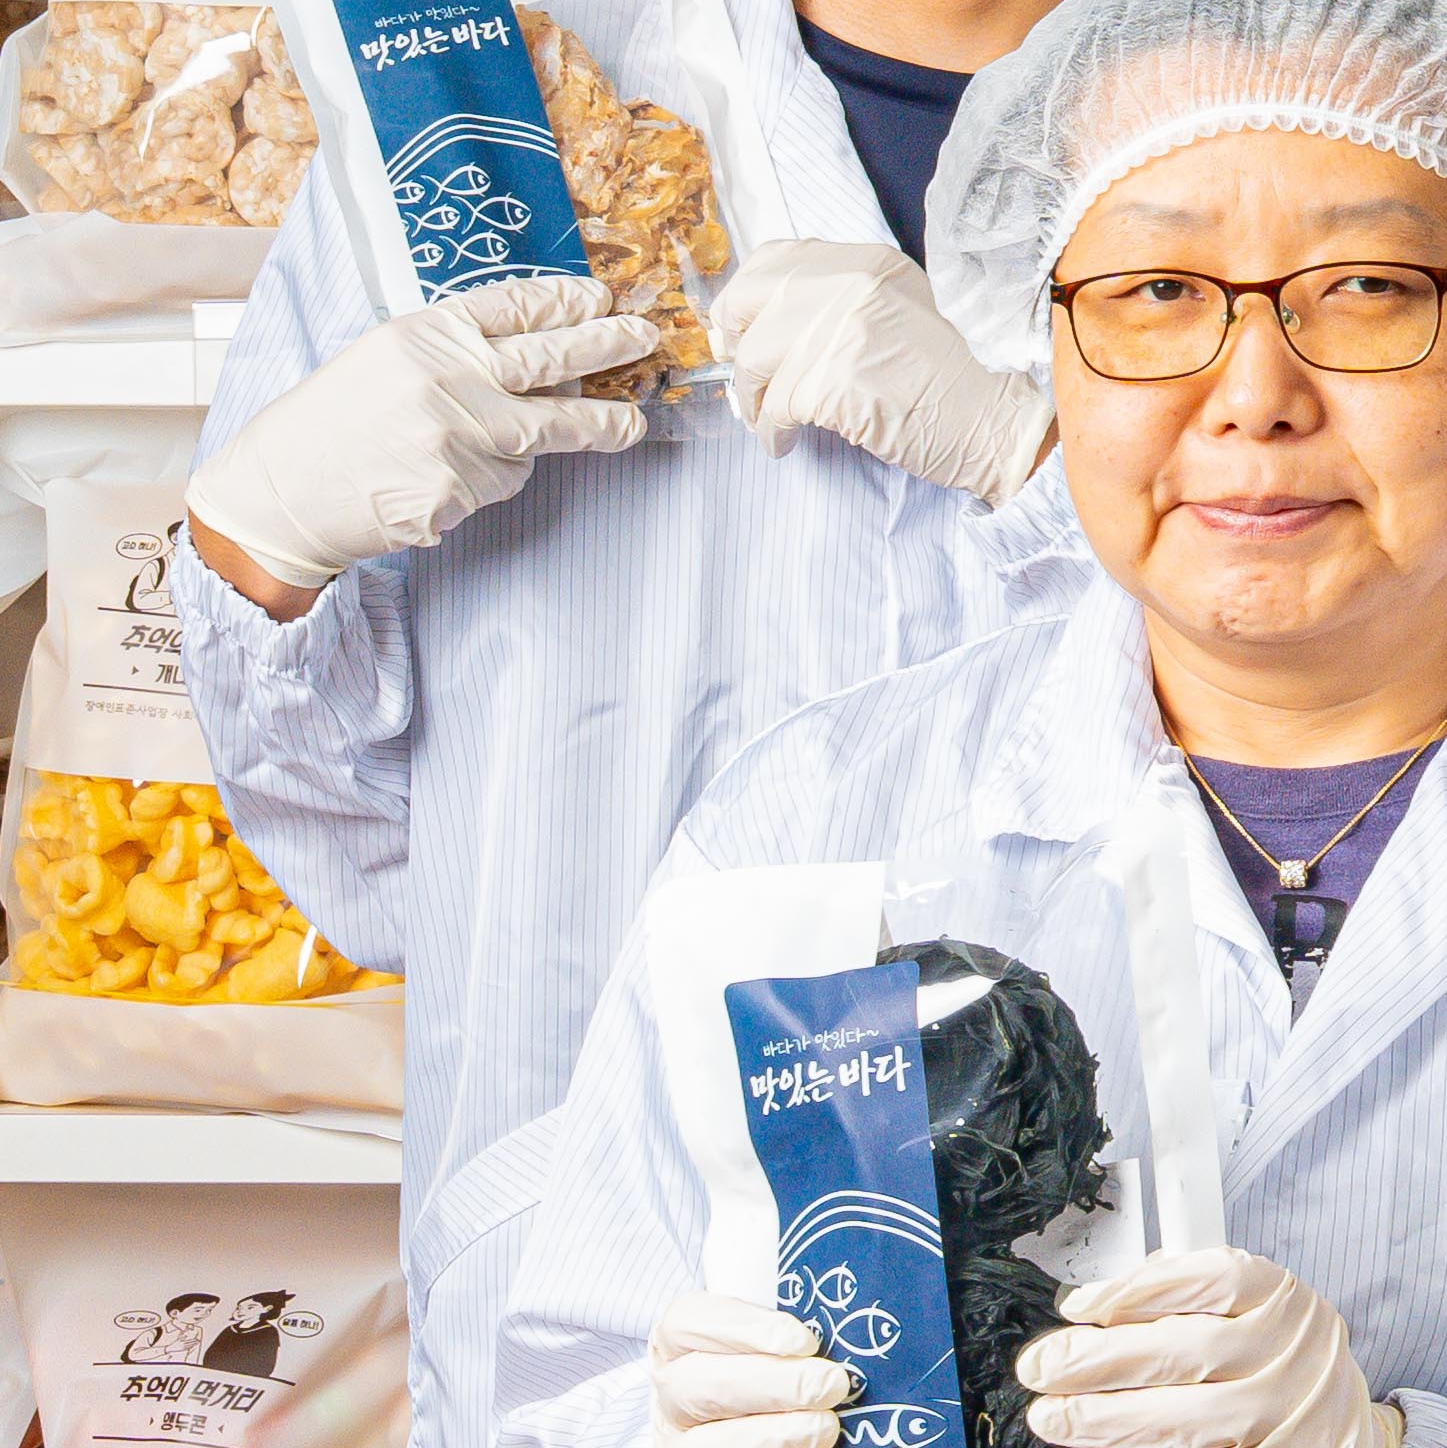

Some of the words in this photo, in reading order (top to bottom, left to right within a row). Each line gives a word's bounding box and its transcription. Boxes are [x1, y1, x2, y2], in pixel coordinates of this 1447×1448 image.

[374, 10, 423, 28] 바다가
[359, 26, 450, 72] 맛있는
[451, 16, 511, 51] 바다
[85, 700, 168, 720] 장애인표준사업장
[762, 1035, 812, 1057] 바다가
[750, 1060, 836, 1116] 맛있는
[838, 1045, 912, 1097] 바다
[120, 1375, 191, 1402] 추억의
[187, 1379, 265, 1413] 먹거리
[161, 1410, 208, 1435] 앵두콘
